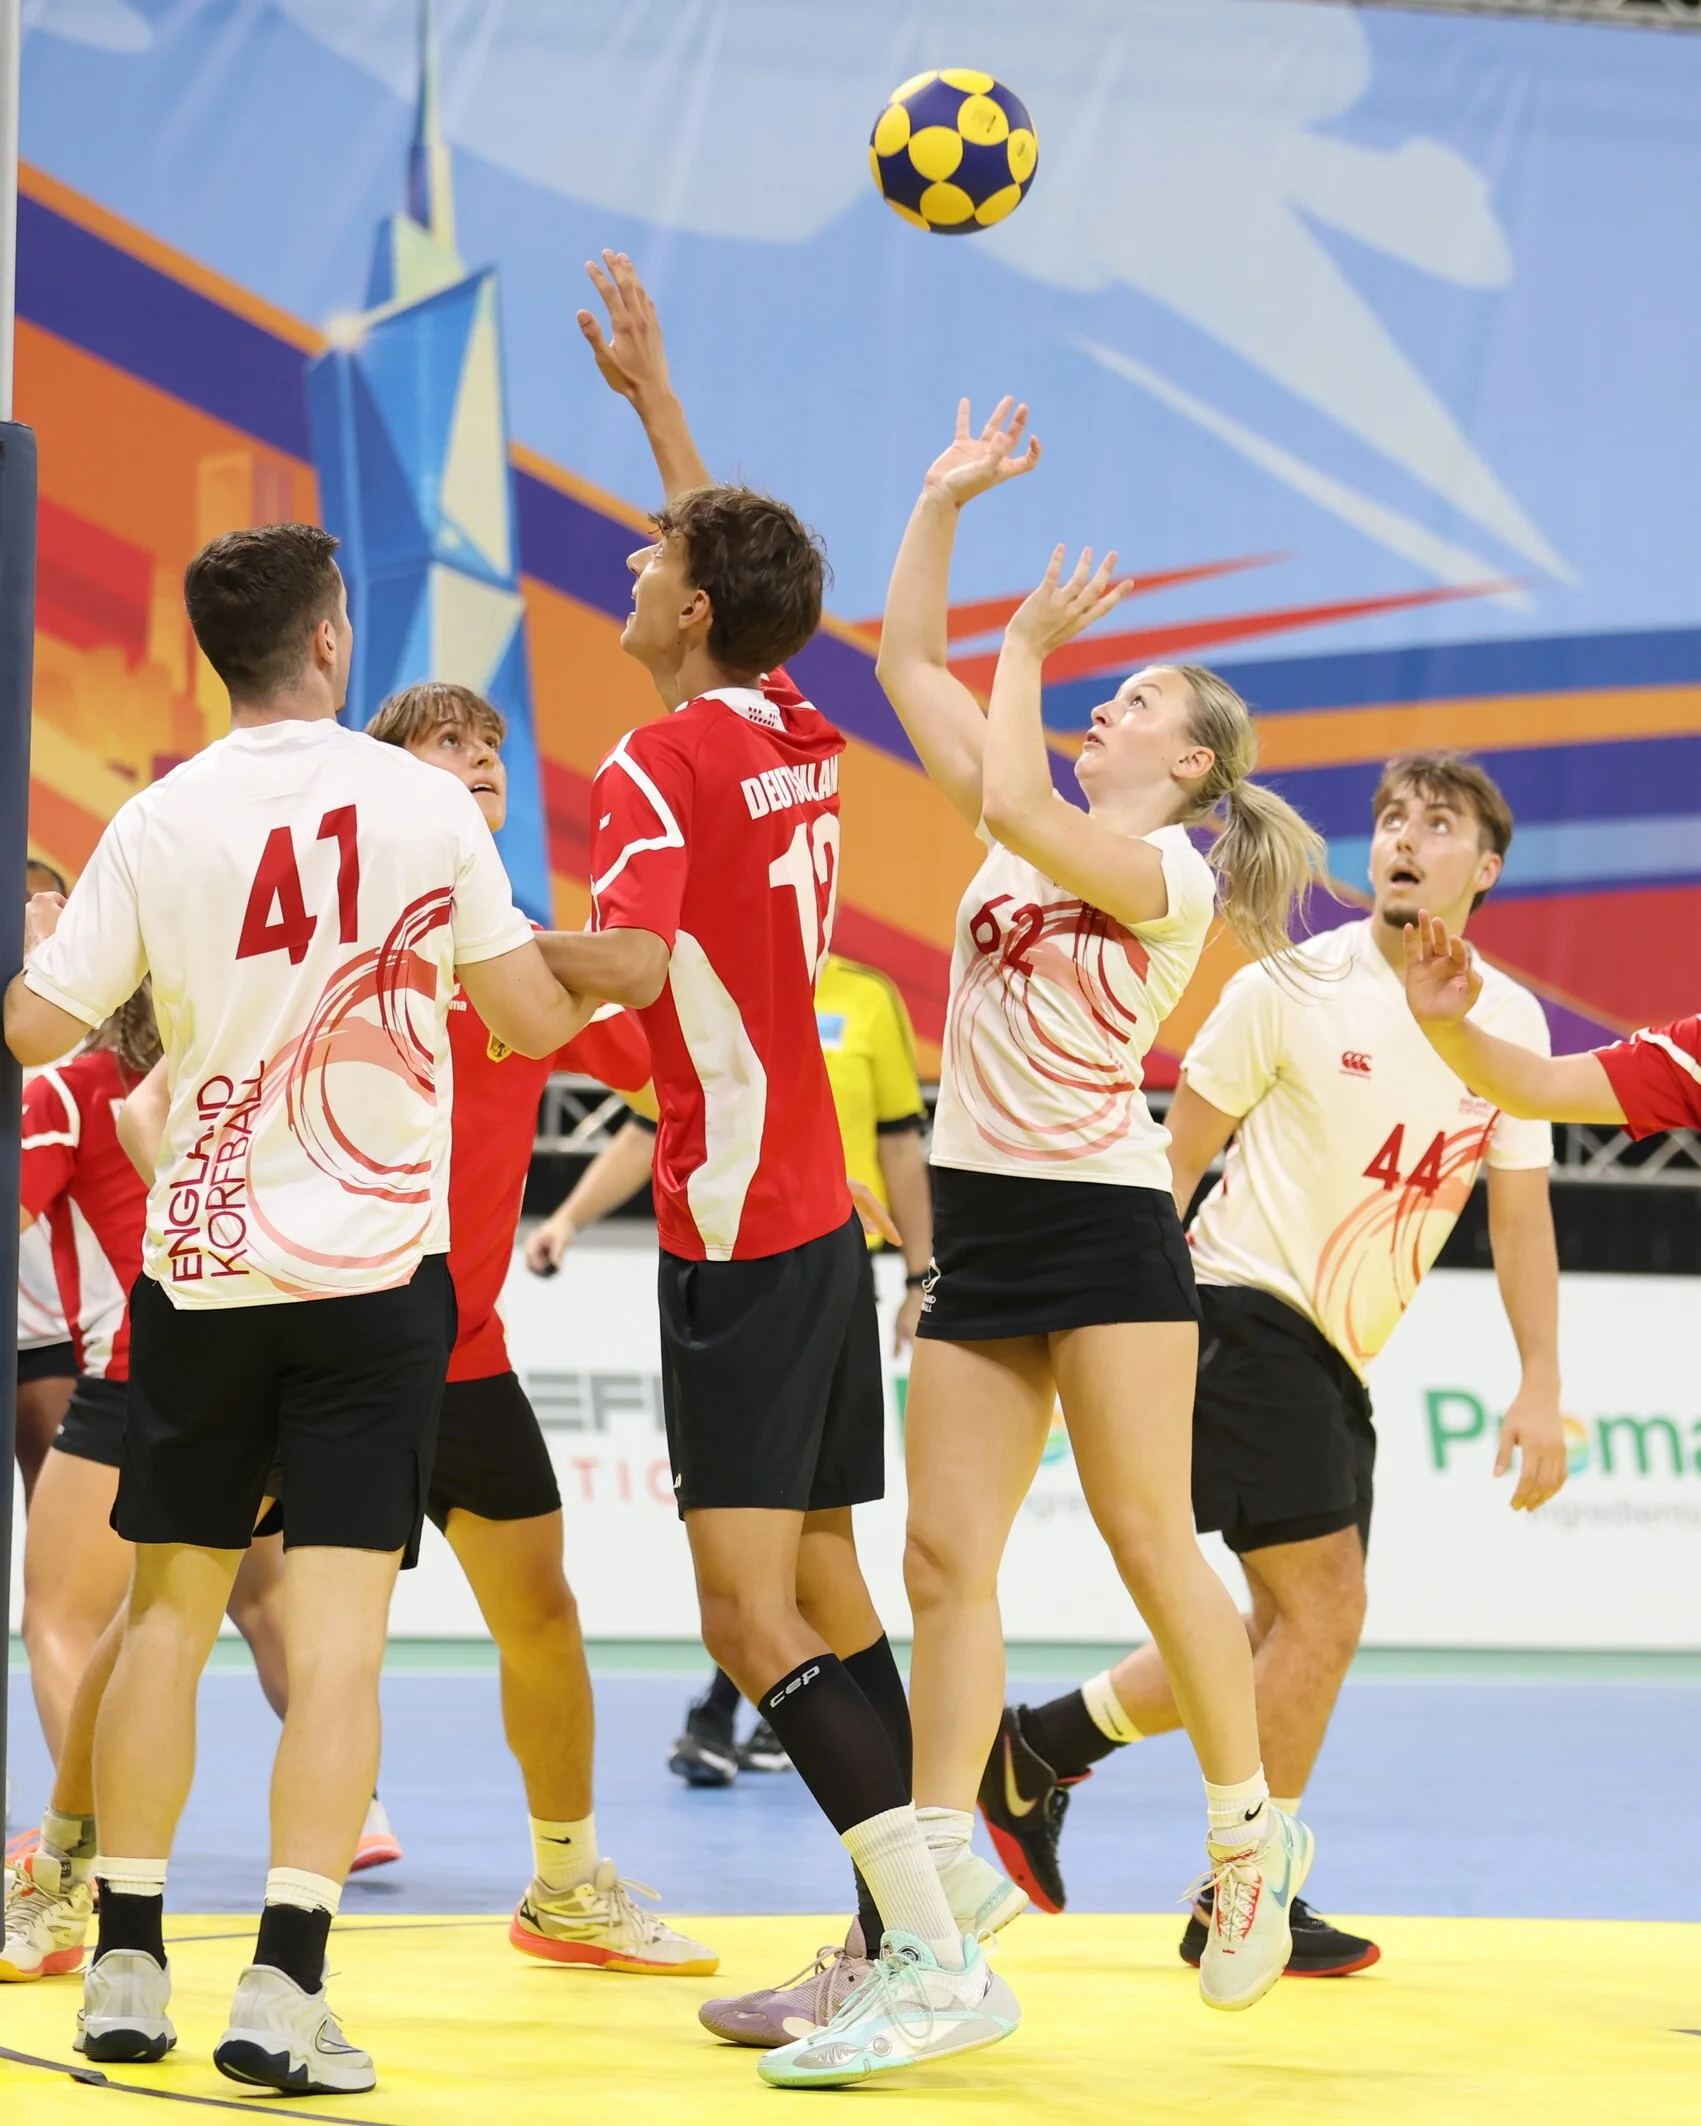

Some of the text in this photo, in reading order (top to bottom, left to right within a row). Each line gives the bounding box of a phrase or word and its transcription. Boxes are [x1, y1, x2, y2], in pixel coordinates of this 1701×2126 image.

[740, 754, 838, 821] DEUTSLAN
[235, 804, 360, 966] 41
[970, 894, 1044, 978] 62
[205, 1060, 265, 1277] KORFBALL
[1362, 1123, 1446, 1197] 44
[769, 1665, 821, 1709] cep
